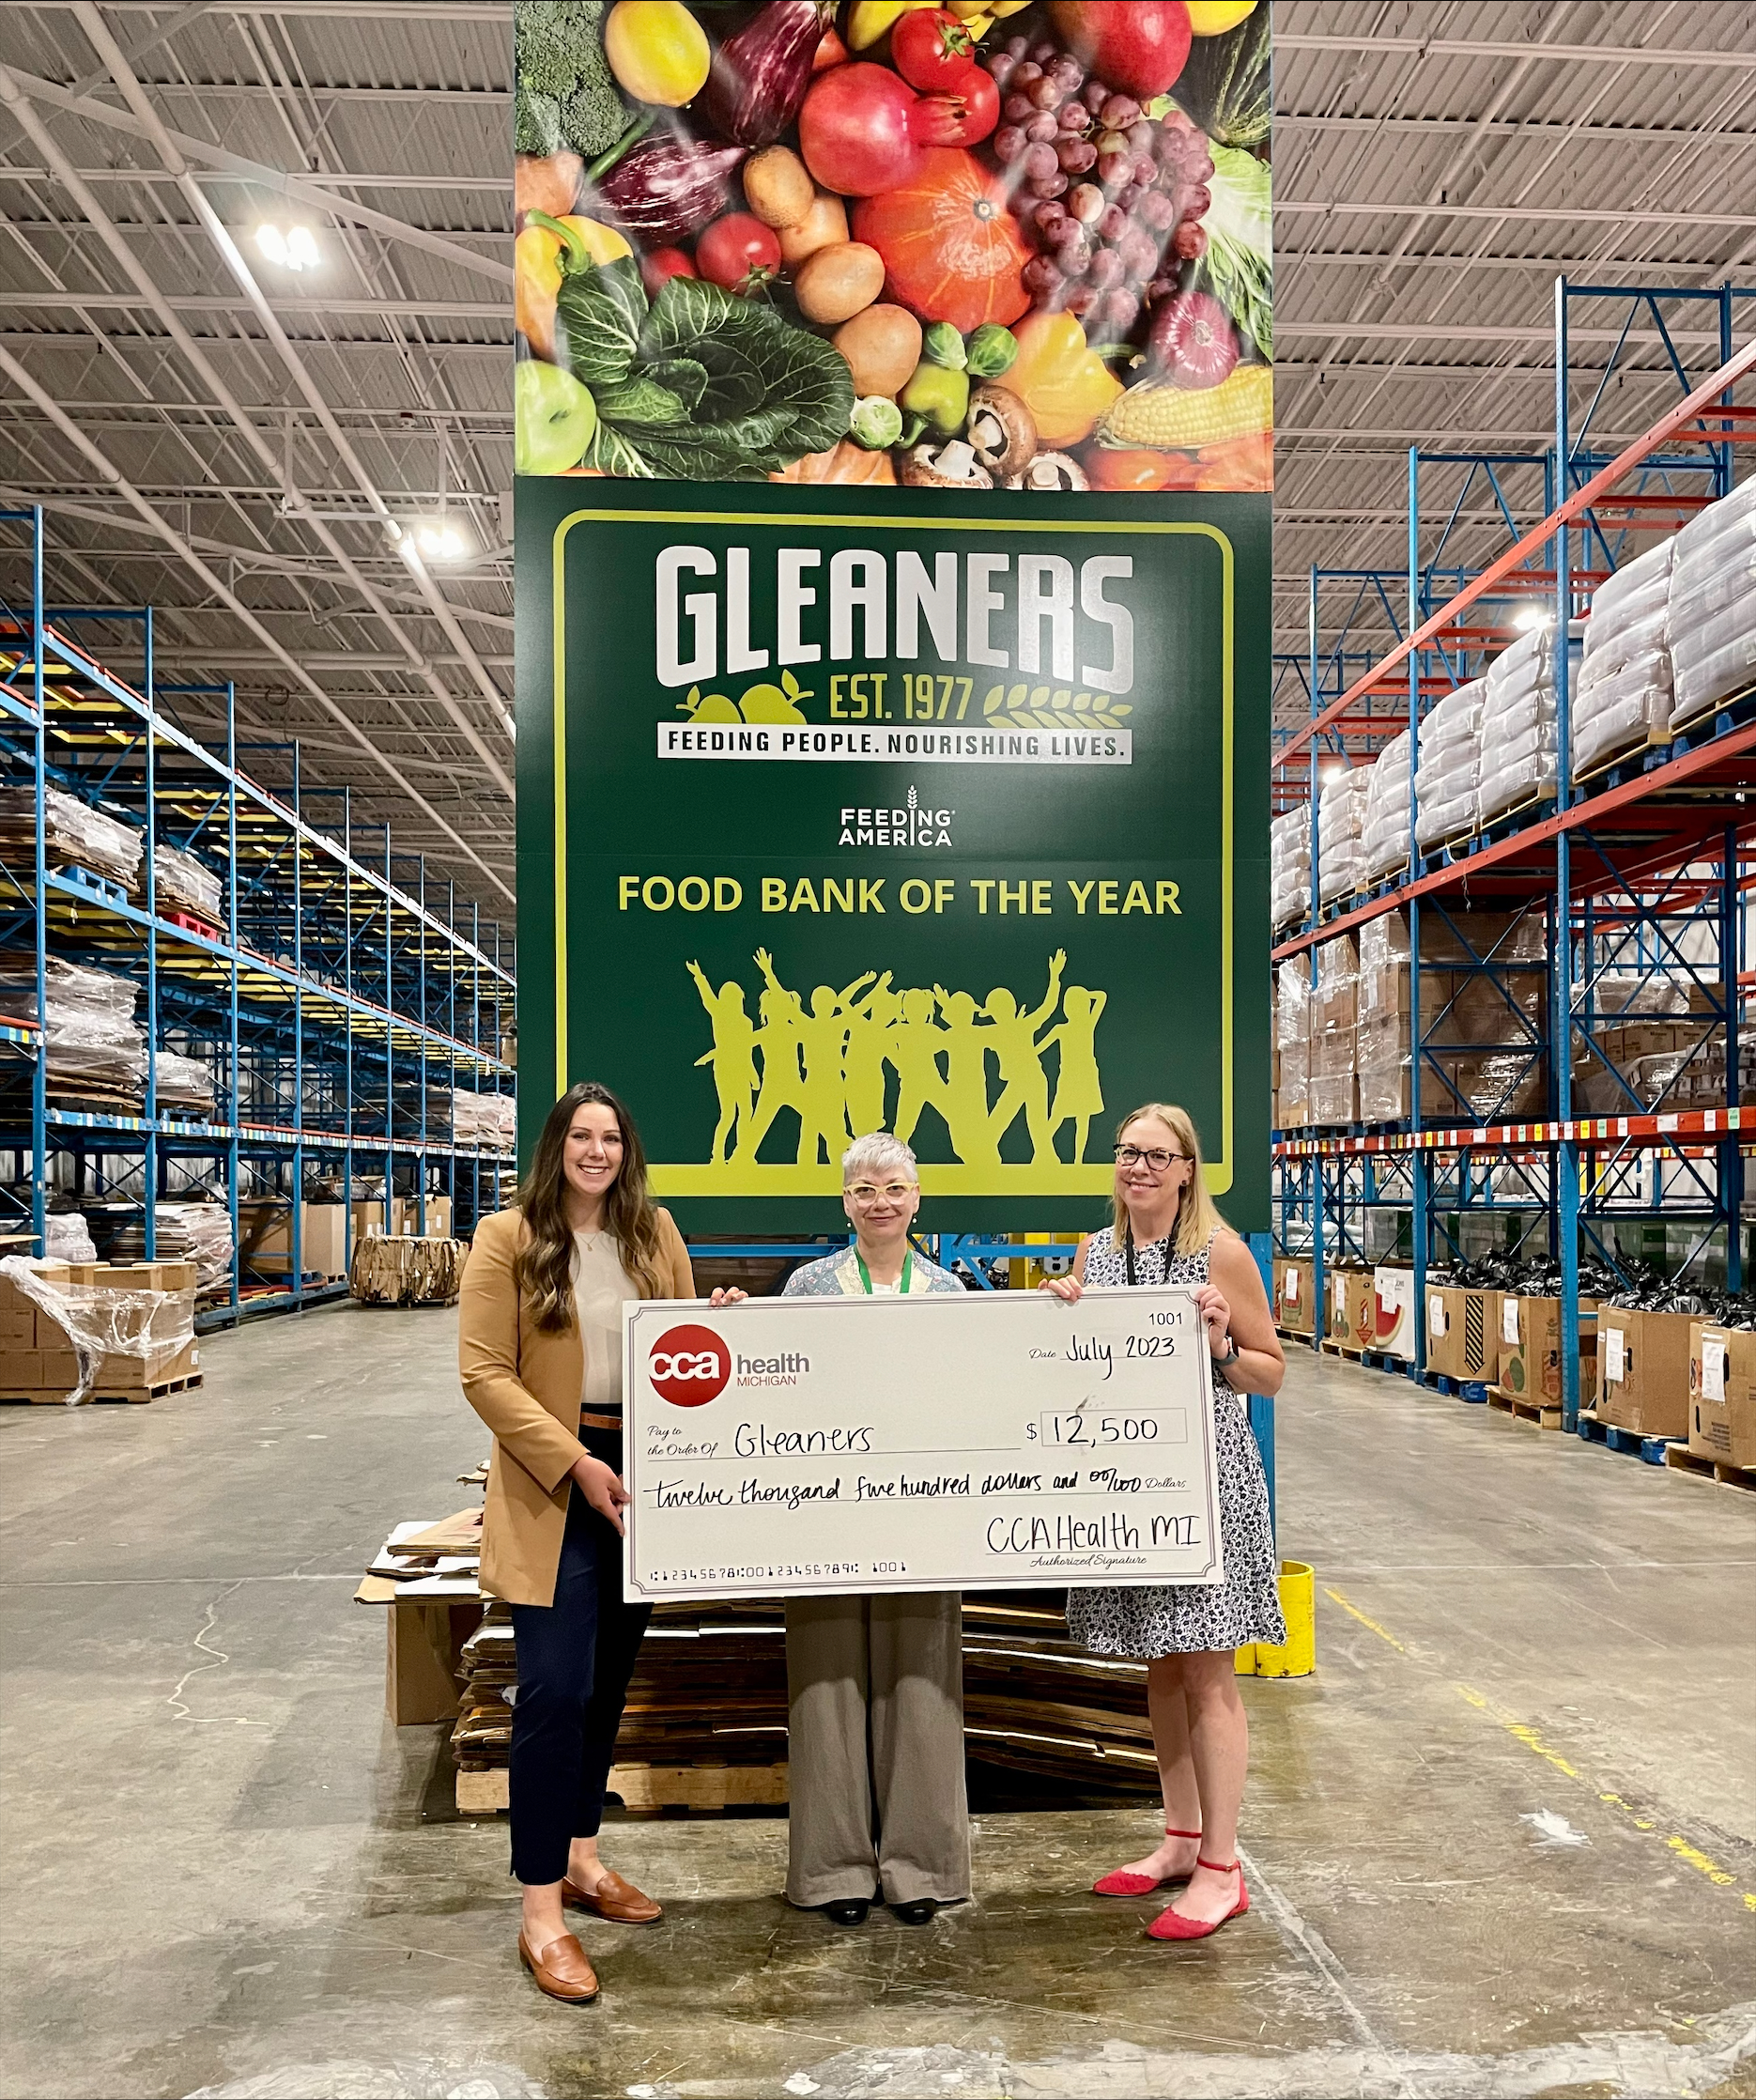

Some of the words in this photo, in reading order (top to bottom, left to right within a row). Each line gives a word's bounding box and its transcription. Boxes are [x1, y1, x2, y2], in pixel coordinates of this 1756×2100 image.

[655, 545, 1134, 695] GLEANERS
[829, 672, 888, 720] EST.
[904, 674, 974, 720] 1977
[668, 730, 770, 752] FEEDING
[782, 732, 880, 754] PEOPLE.
[887, 733, 1040, 756] NOURISHING
[1051, 735, 1125, 757] LIVES.
[840, 808, 951, 827] FEEDING
[839, 827, 953, 847] AMERICA
[618, 875, 743, 913] FOOD
[762, 877, 886, 914] BANK
[899, 878, 954, 915] OF
[971, 879, 1052, 915] THE
[1067, 880, 1182, 916] YEAR
[1148, 1312, 1182, 1325] 1001
[648, 1351, 720, 1382] cca
[736, 1352, 810, 1375] health
[1028, 1348, 1057, 1359] Date
[1066, 1335, 1113, 1381] July
[1125, 1336, 1176, 1358] 2023
[736, 1375, 797, 1387] MICHIGAN
[647, 1425, 670, 1440] Pay
[671, 1427, 683, 1436] to
[735, 1423, 874, 1458] Gleaners
[1054, 1414, 1158, 1448] 12,500
[647, 1444, 665, 1456] the
[667, 1444, 699, 1456] Order
[701, 1442, 718, 1459] Of
[642, 1479, 733, 1508] twelve
[738, 1478, 839, 1510] thousand
[855, 1475, 895, 1503] five
[901, 1474, 970, 1496] hundred
[981, 1473, 1042, 1492] dollars
[1053, 1471, 1079, 1490] and
[1145, 1477, 1187, 1490] Dollars
[987, 1516, 1051, 1553] CCA
[1057, 1512, 1139, 1551] Health
[1151, 1514, 1201, 1546] MI
[871, 1562, 907, 1574] 1001
[1030, 1554, 1092, 1568] Authorized
[1092, 1553, 1148, 1569] Signature
